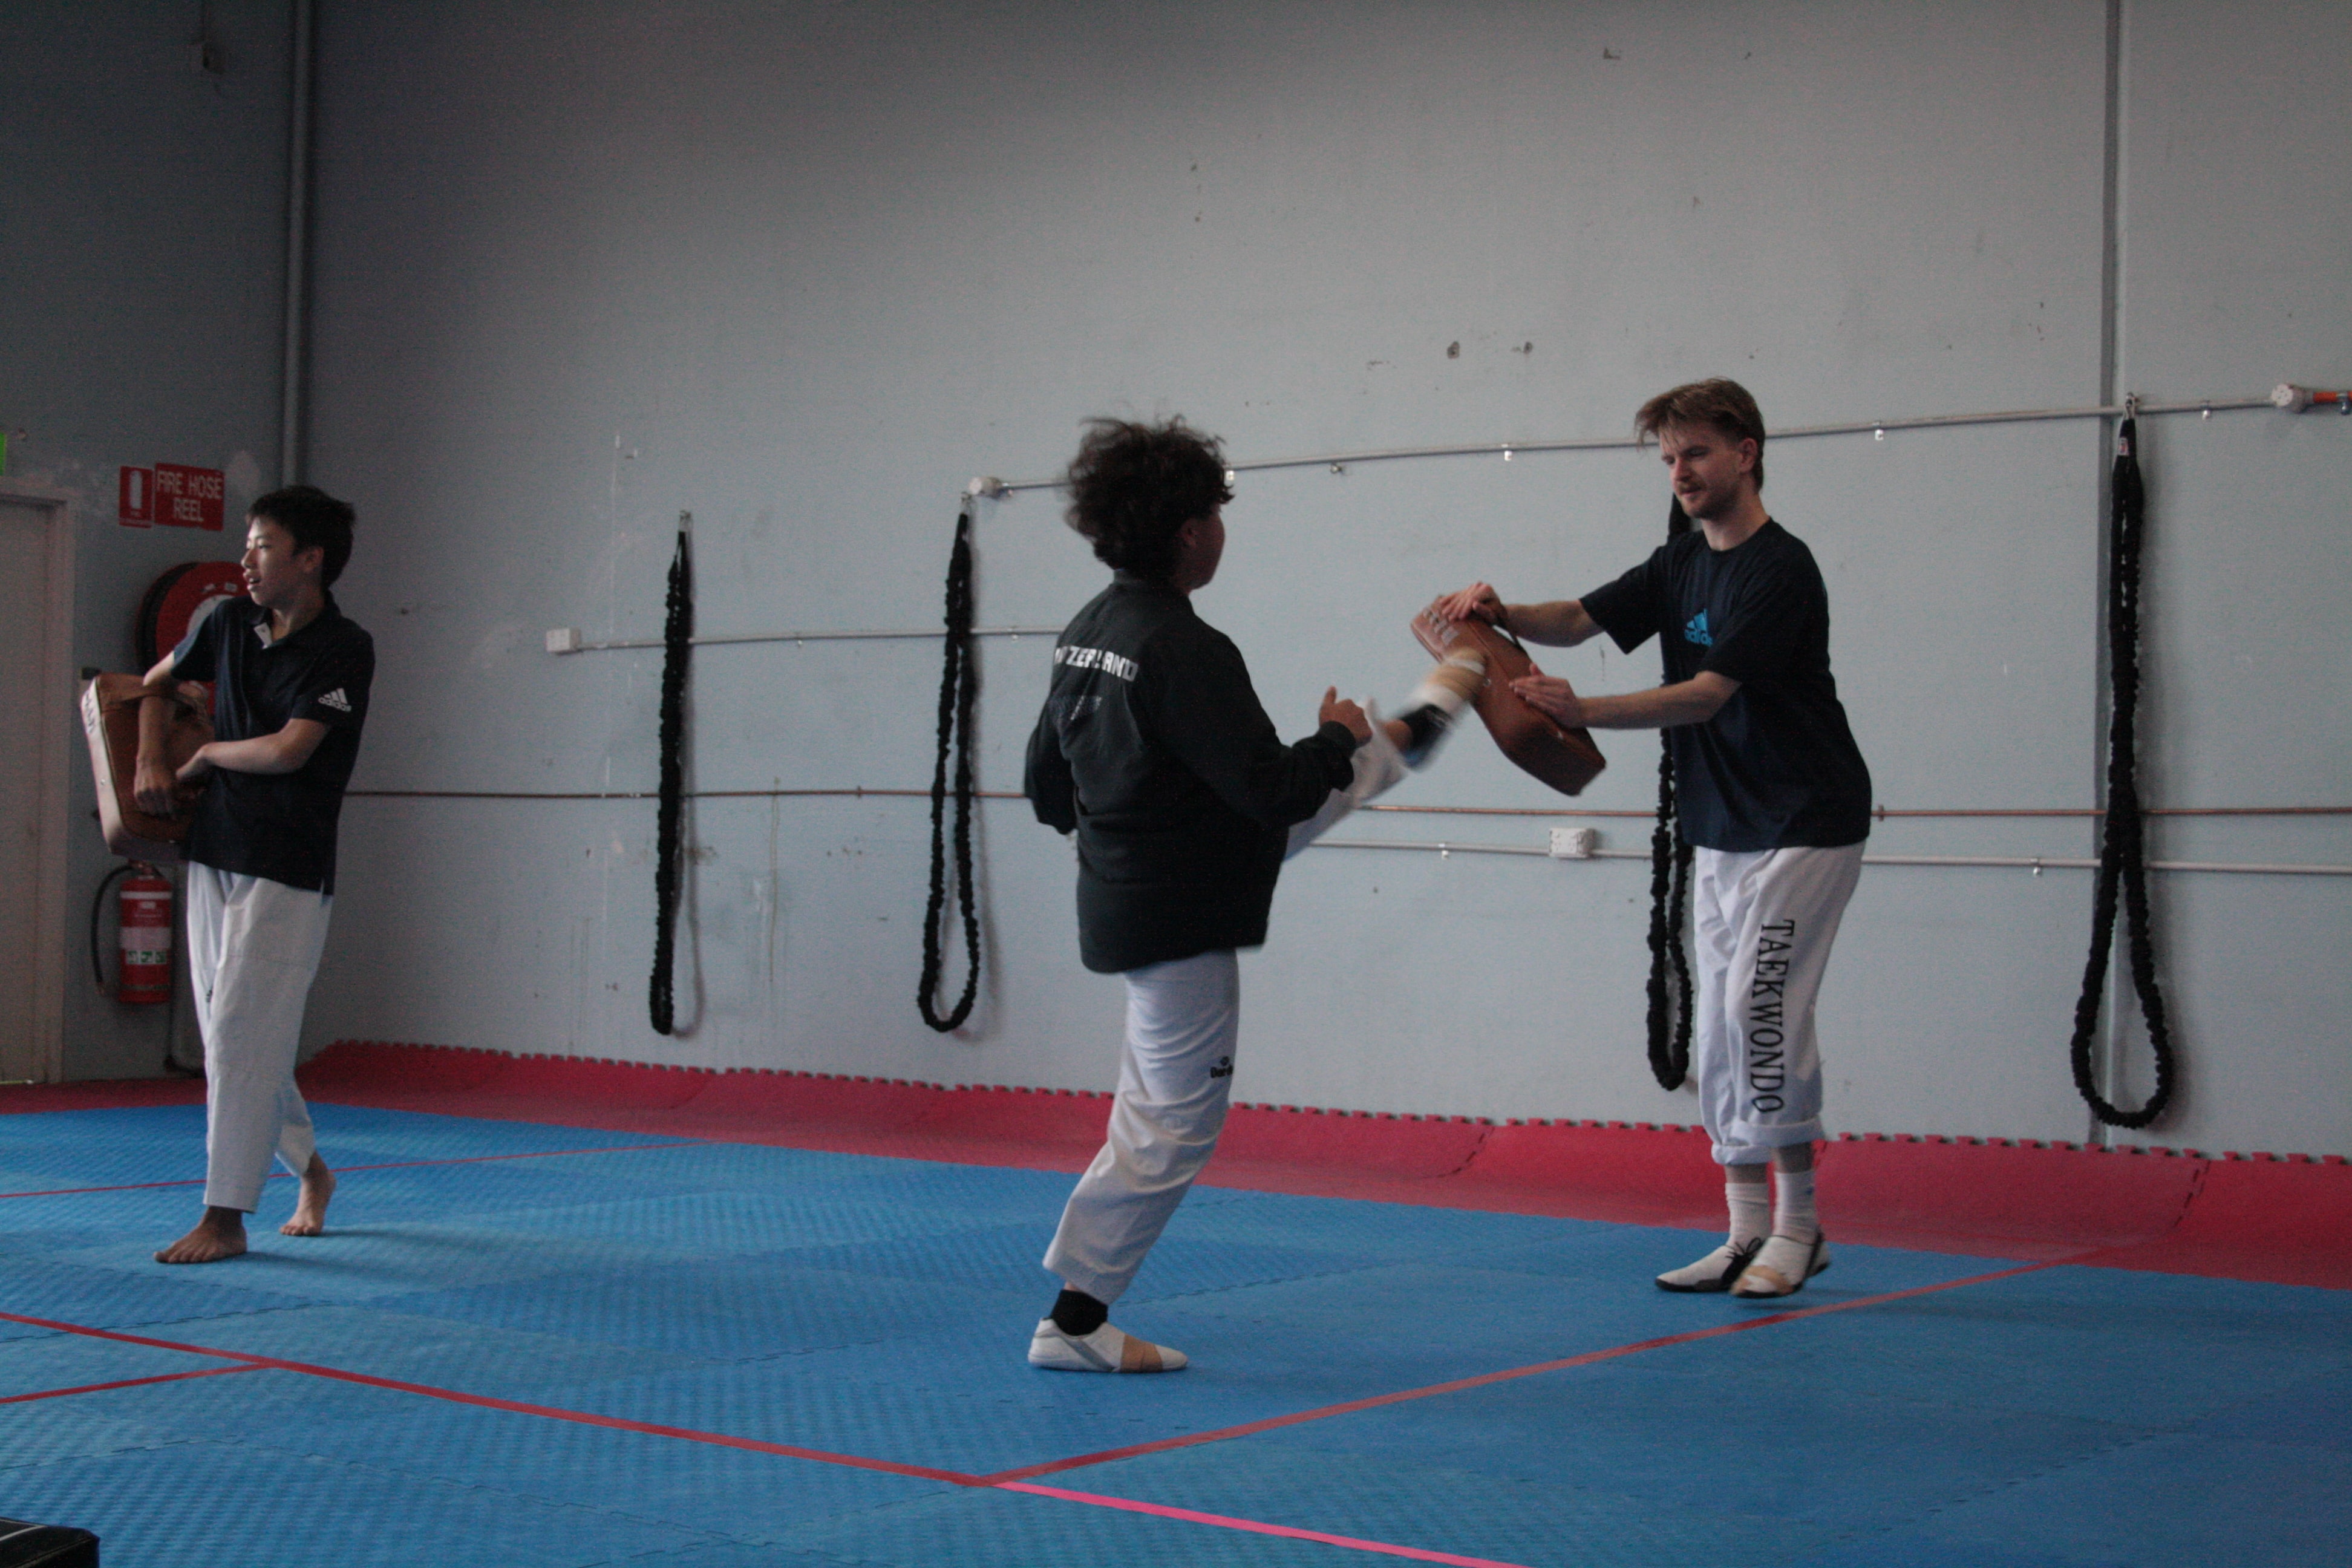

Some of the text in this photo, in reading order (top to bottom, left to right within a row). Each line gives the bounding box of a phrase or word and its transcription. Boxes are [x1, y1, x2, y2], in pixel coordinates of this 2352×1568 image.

[157, 470, 223, 499] FIRE HOSE
[173, 498, 204, 522] REEL
[1749, 919, 1795, 1112] TAEKWONDO
